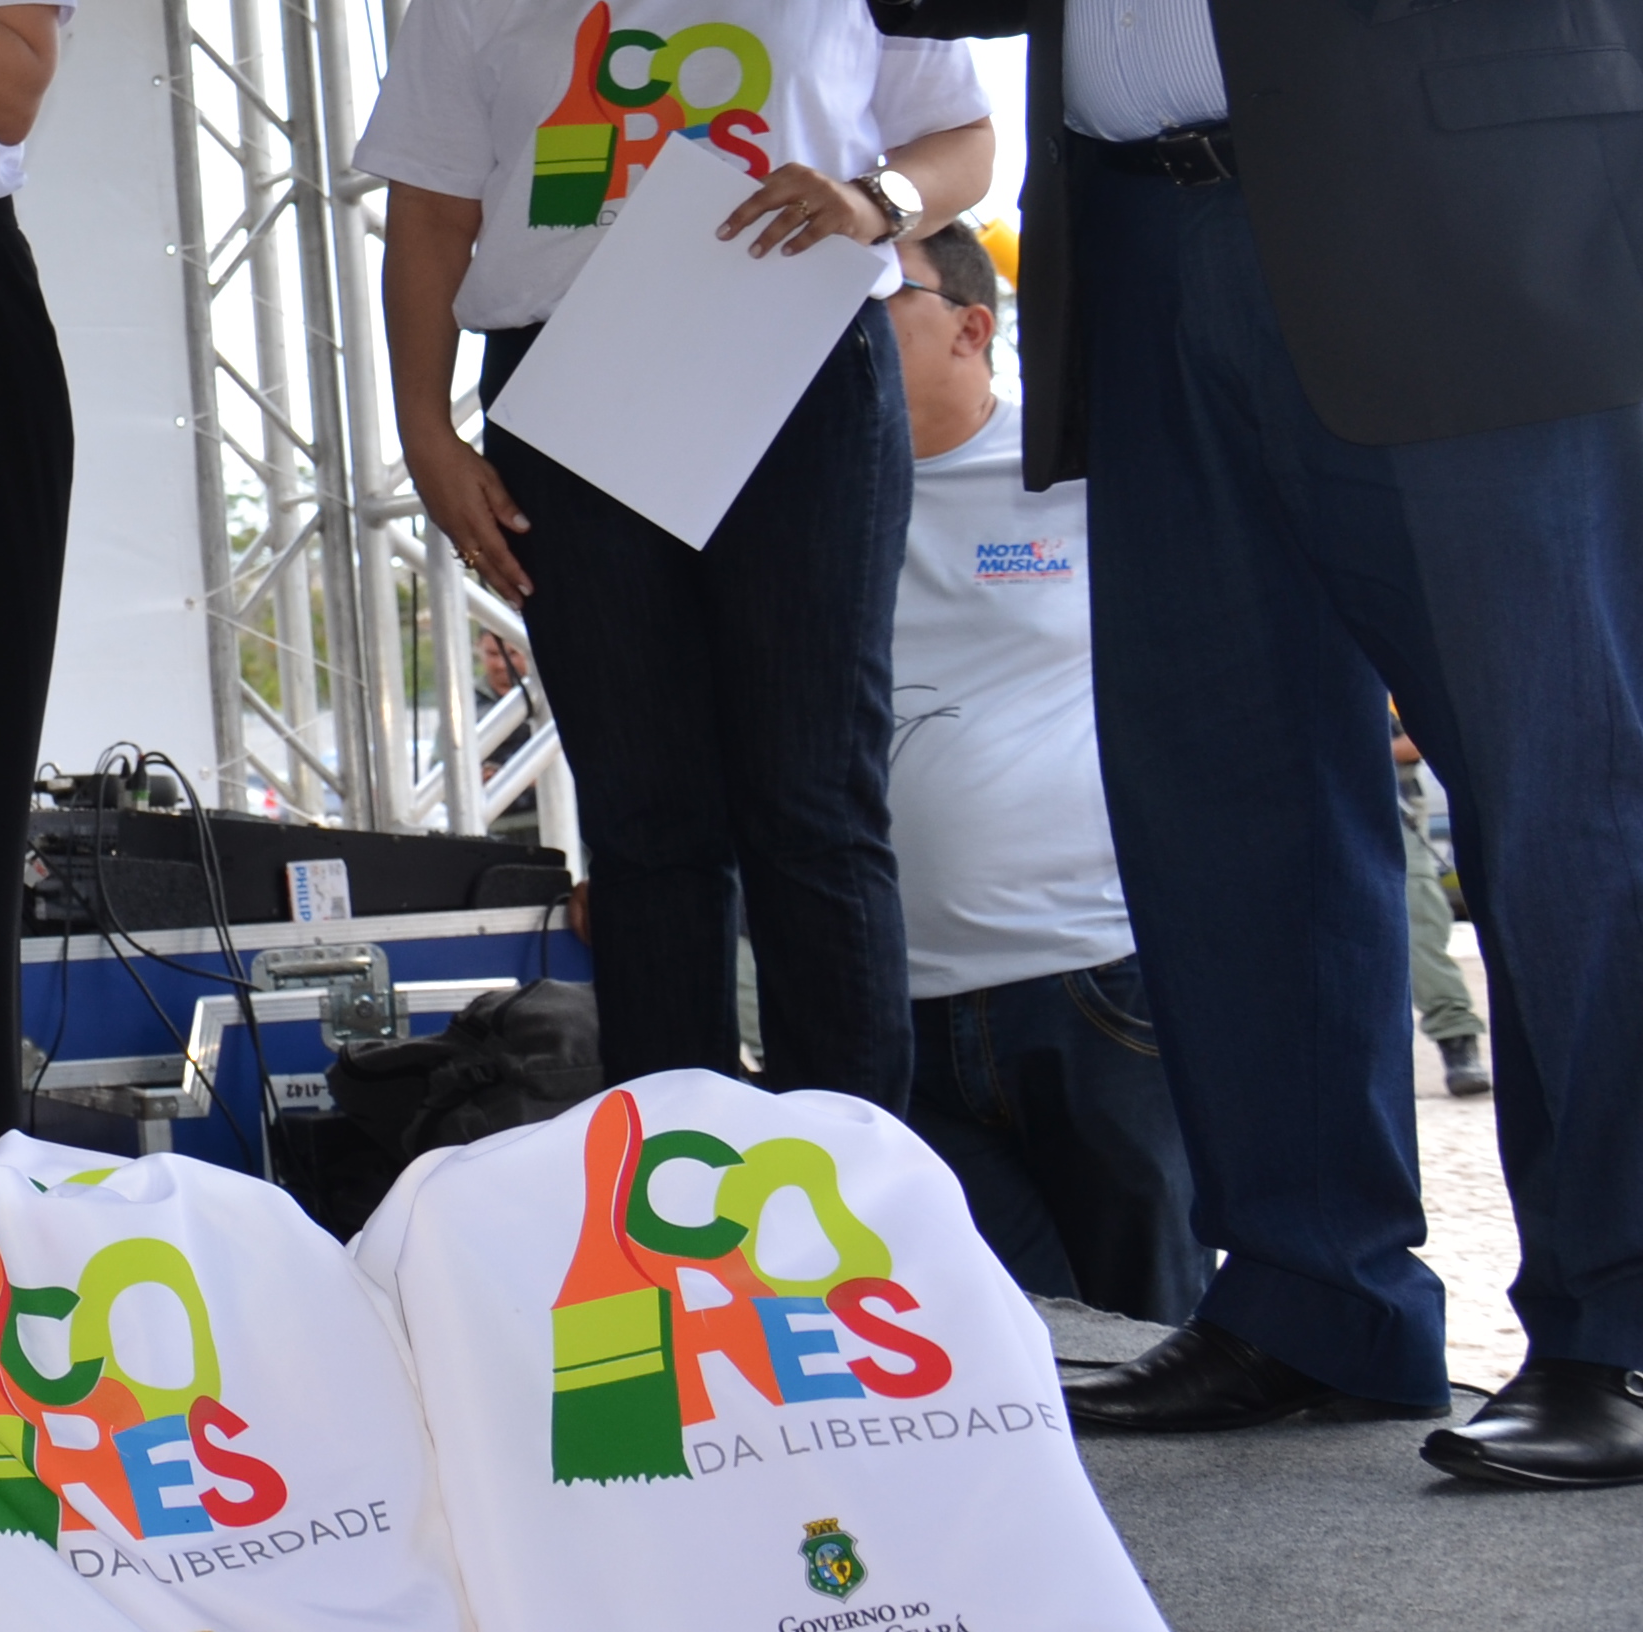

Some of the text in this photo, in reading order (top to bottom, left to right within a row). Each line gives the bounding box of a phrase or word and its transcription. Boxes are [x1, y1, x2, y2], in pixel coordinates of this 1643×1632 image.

[977, 543, 1034, 558] NOTA
[977, 558, 1071, 573] MUSICAL
[692, 1401, 1063, 1475] DA LIBERDADE
[71, 1500, 391, 1585] DA LIBERDADE
